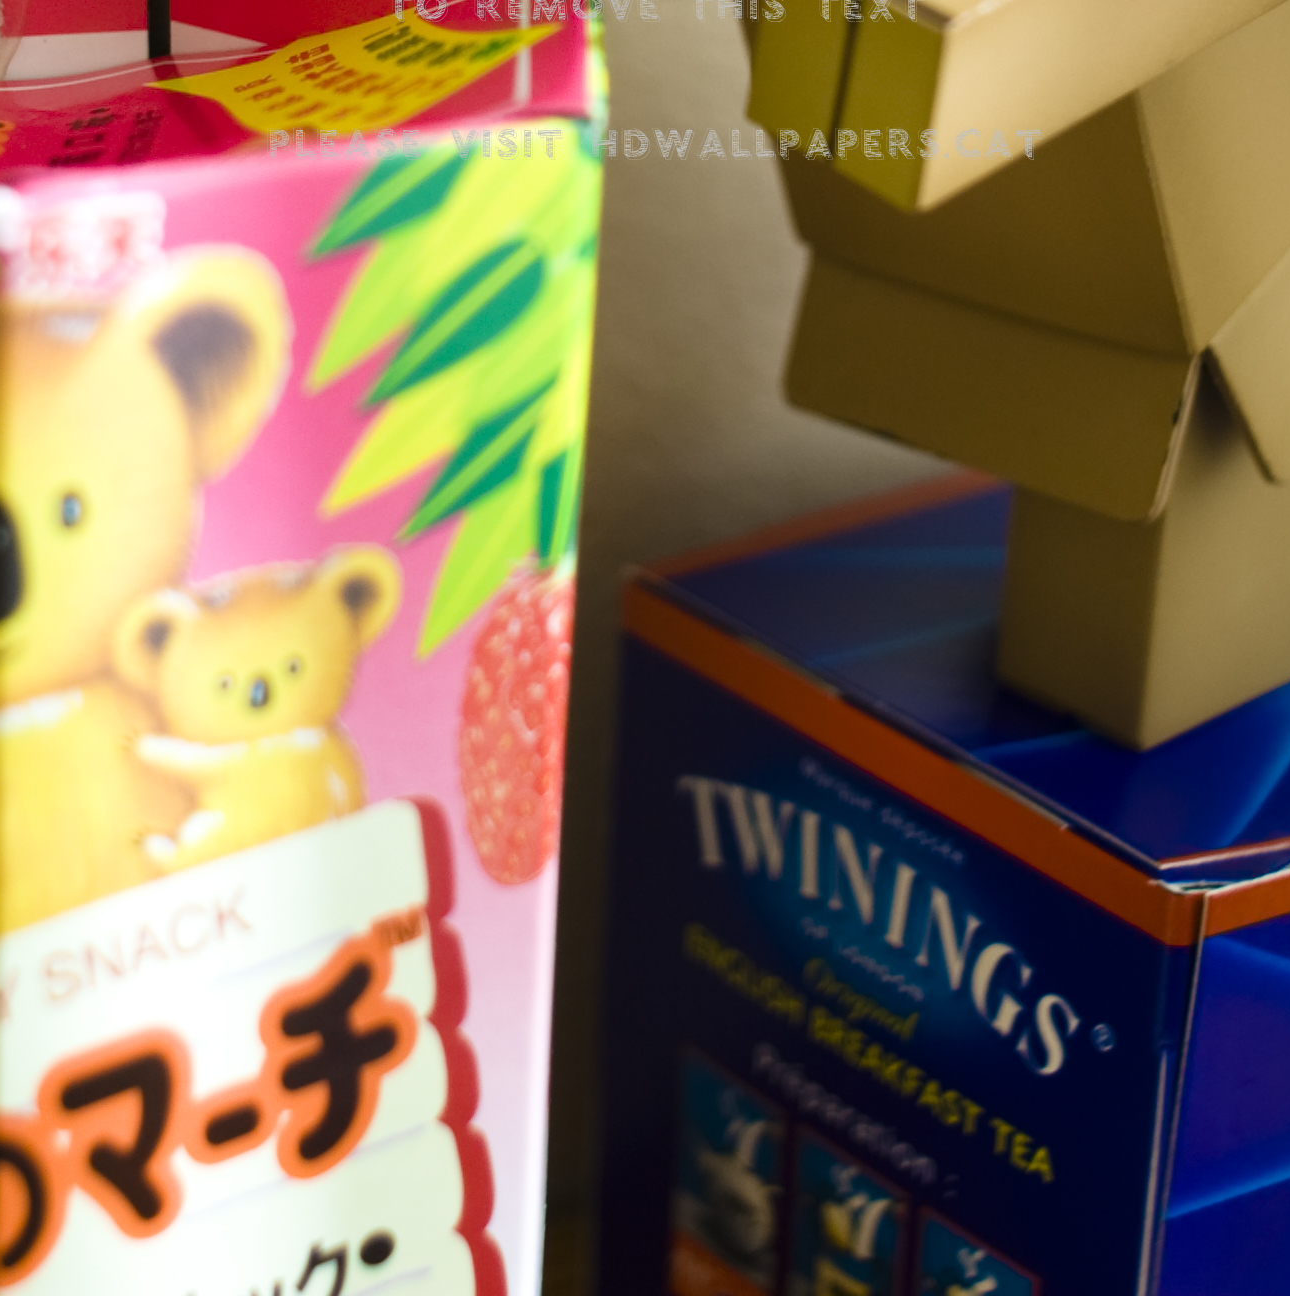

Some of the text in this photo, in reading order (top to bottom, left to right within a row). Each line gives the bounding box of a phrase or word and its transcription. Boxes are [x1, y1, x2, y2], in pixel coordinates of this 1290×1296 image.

[40, 884, 254, 1008] SNACK
[676, 775, 1081, 1075] TWININGS
[808, 1006, 985, 1135] BREAKFAST
[990, 1117, 1055, 1184] TEA
